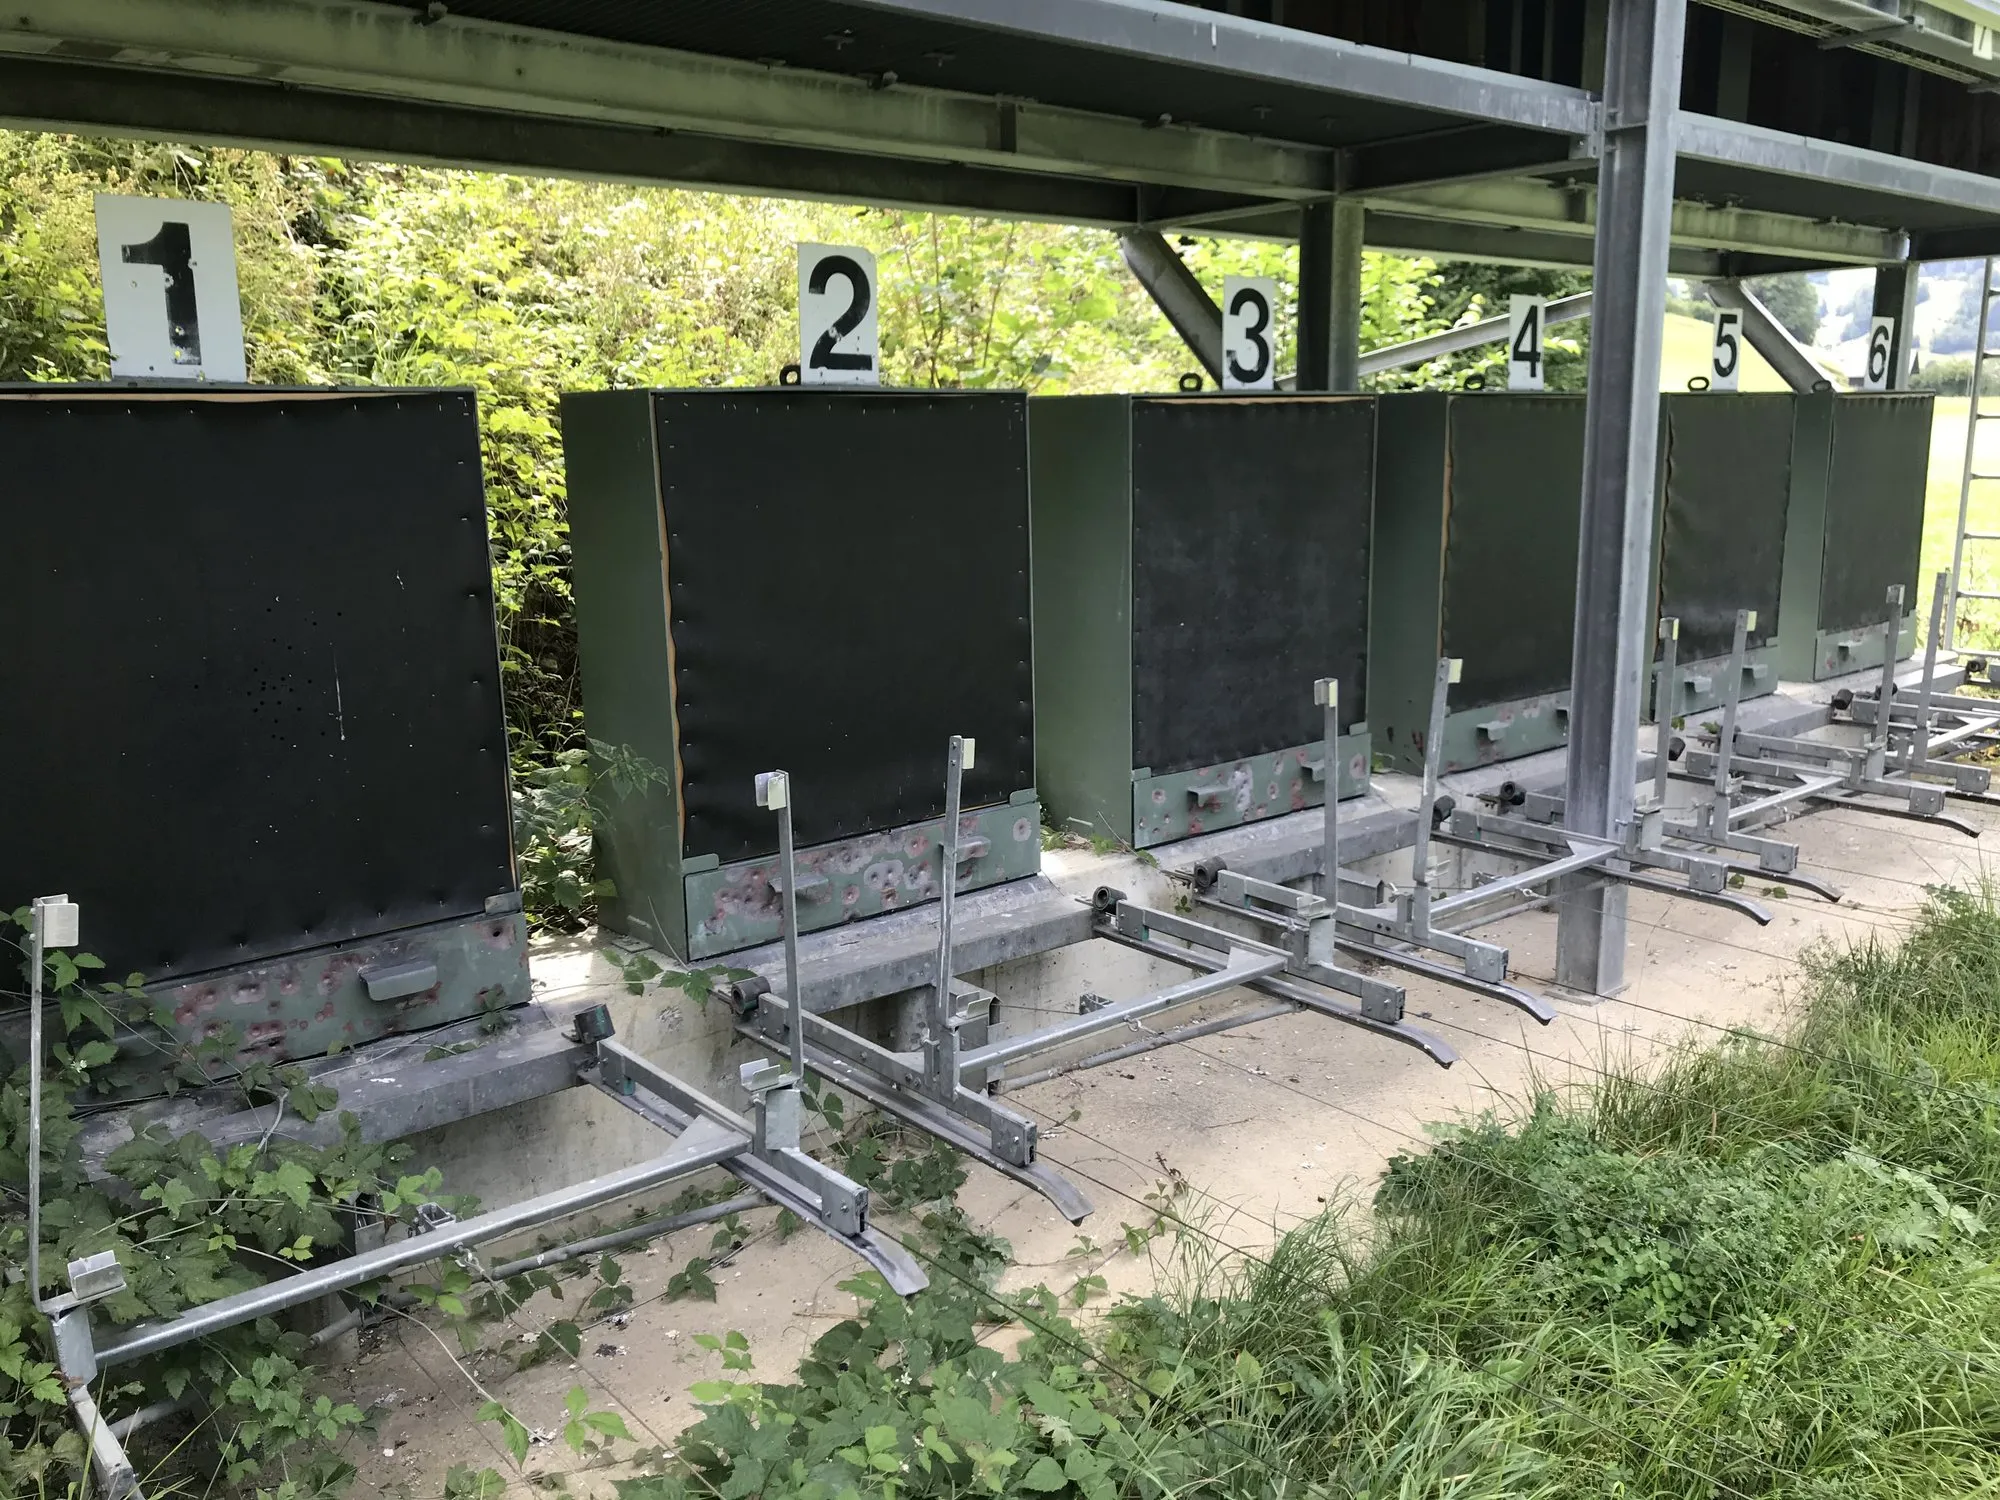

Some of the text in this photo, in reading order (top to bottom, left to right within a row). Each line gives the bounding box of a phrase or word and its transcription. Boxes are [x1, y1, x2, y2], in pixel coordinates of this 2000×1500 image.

[121, 221, 202, 365] 1
[809, 255, 872, 370] 2
[1224, 288, 1271, 384] 3
[1513, 305, 1542, 377] 4
[1714, 314, 1737, 378] 5
[1869, 326, 1889, 383] 6
